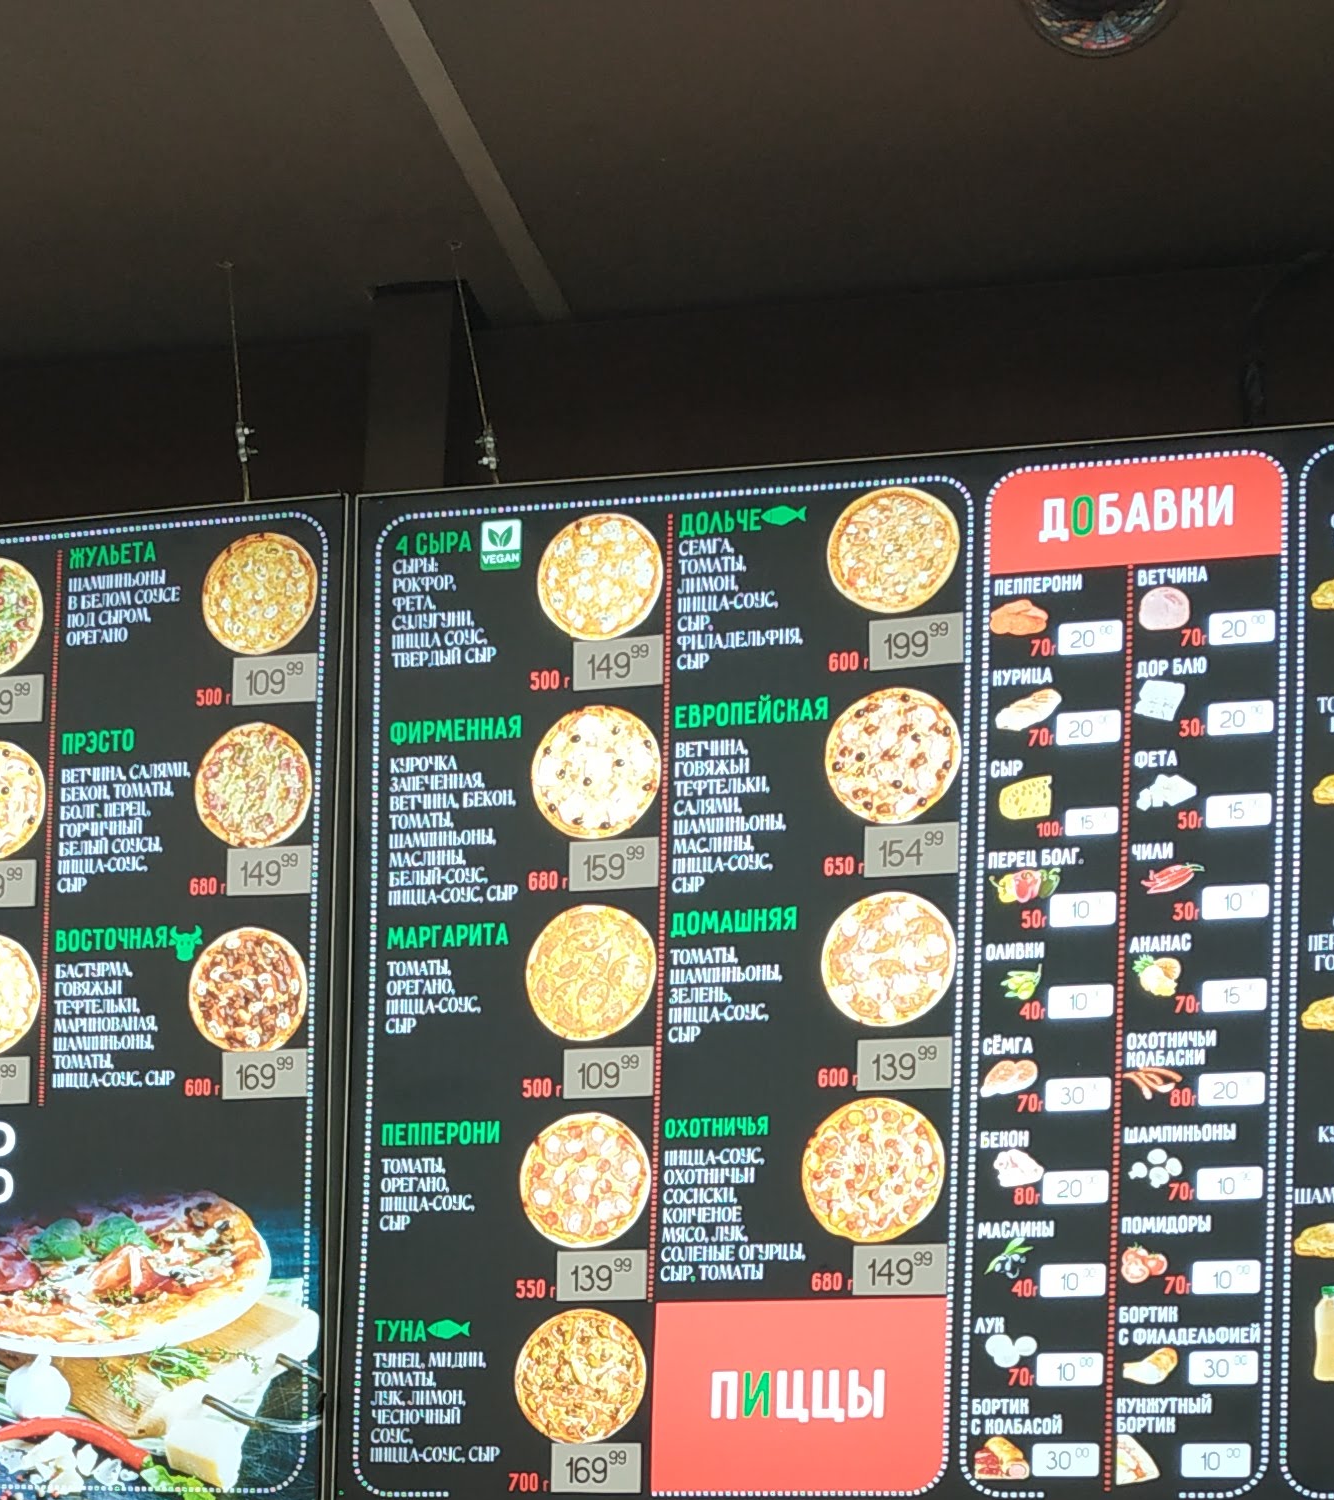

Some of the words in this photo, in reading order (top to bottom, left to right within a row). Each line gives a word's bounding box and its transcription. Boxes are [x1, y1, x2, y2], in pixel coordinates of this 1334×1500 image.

[679, 509, 764, 538] ДОЛЬЧЕ
[1039, 485, 1234, 543] ДОБАВКИ
[396, 536, 407, 555] 4
[416, 531, 471, 555] СЫРА
[70, 542, 155, 569] ЖУЛЬЕТА
[481, 552, 520, 566] VEGAN
[994, 574, 1082, 596] ПЕППЕРОНИ
[1138, 566, 1207, 588] ВЕТЧИНА
[993, 667, 1052, 686] КУРИЦА
[1136, 659, 1169, 681] ДОР
[1172, 656, 1207, 675] БЛЮ
[675, 694, 828, 729] ЕВРОПЕЙСКАЯ
[390, 715, 521, 745] ФИРМЕННАЯ
[62, 728, 134, 755] ПРЭСТО
[990, 760, 1023, 778] СЫР
[1134, 750, 1177, 768] ФЕТА
[988, 850, 1040, 872] ПЕРЕЦ
[1132, 842, 1173, 861] ЧИЛИ
[670, 906, 797, 938] ДОМАШНЯЯ
[55, 926, 170, 952] ВОСТОЧНАЯ
[387, 923, 509, 949] МАРГАРИТА
[1129, 933, 1191, 953] АНАНАС
[985, 942, 1044, 961] ОЛИВКИ
[983, 1034, 1033, 1055] СЁМГА
[1127, 1030, 1217, 1051] ОХОТНИЧЬИ
[1126, 1046, 1205, 1070] КОЛБАСКИ
[382, 1121, 500, 1146] ПЕППЕРОНИ
[664, 1116, 768, 1139] ОХОТНИЧЬЯ
[1124, 1123, 1236, 1144] ШАМПИНЬОНЫ
[980, 1130, 1029, 1151] БЕКОН
[978, 1221, 1054, 1241] МАСЛИНЫ
[1121, 1215, 1211, 1234] ПОМИДОРЫ
[375, 1320, 430, 1342] ТУНА
[711, 1370, 885, 1423] ПИЦЦЫ
